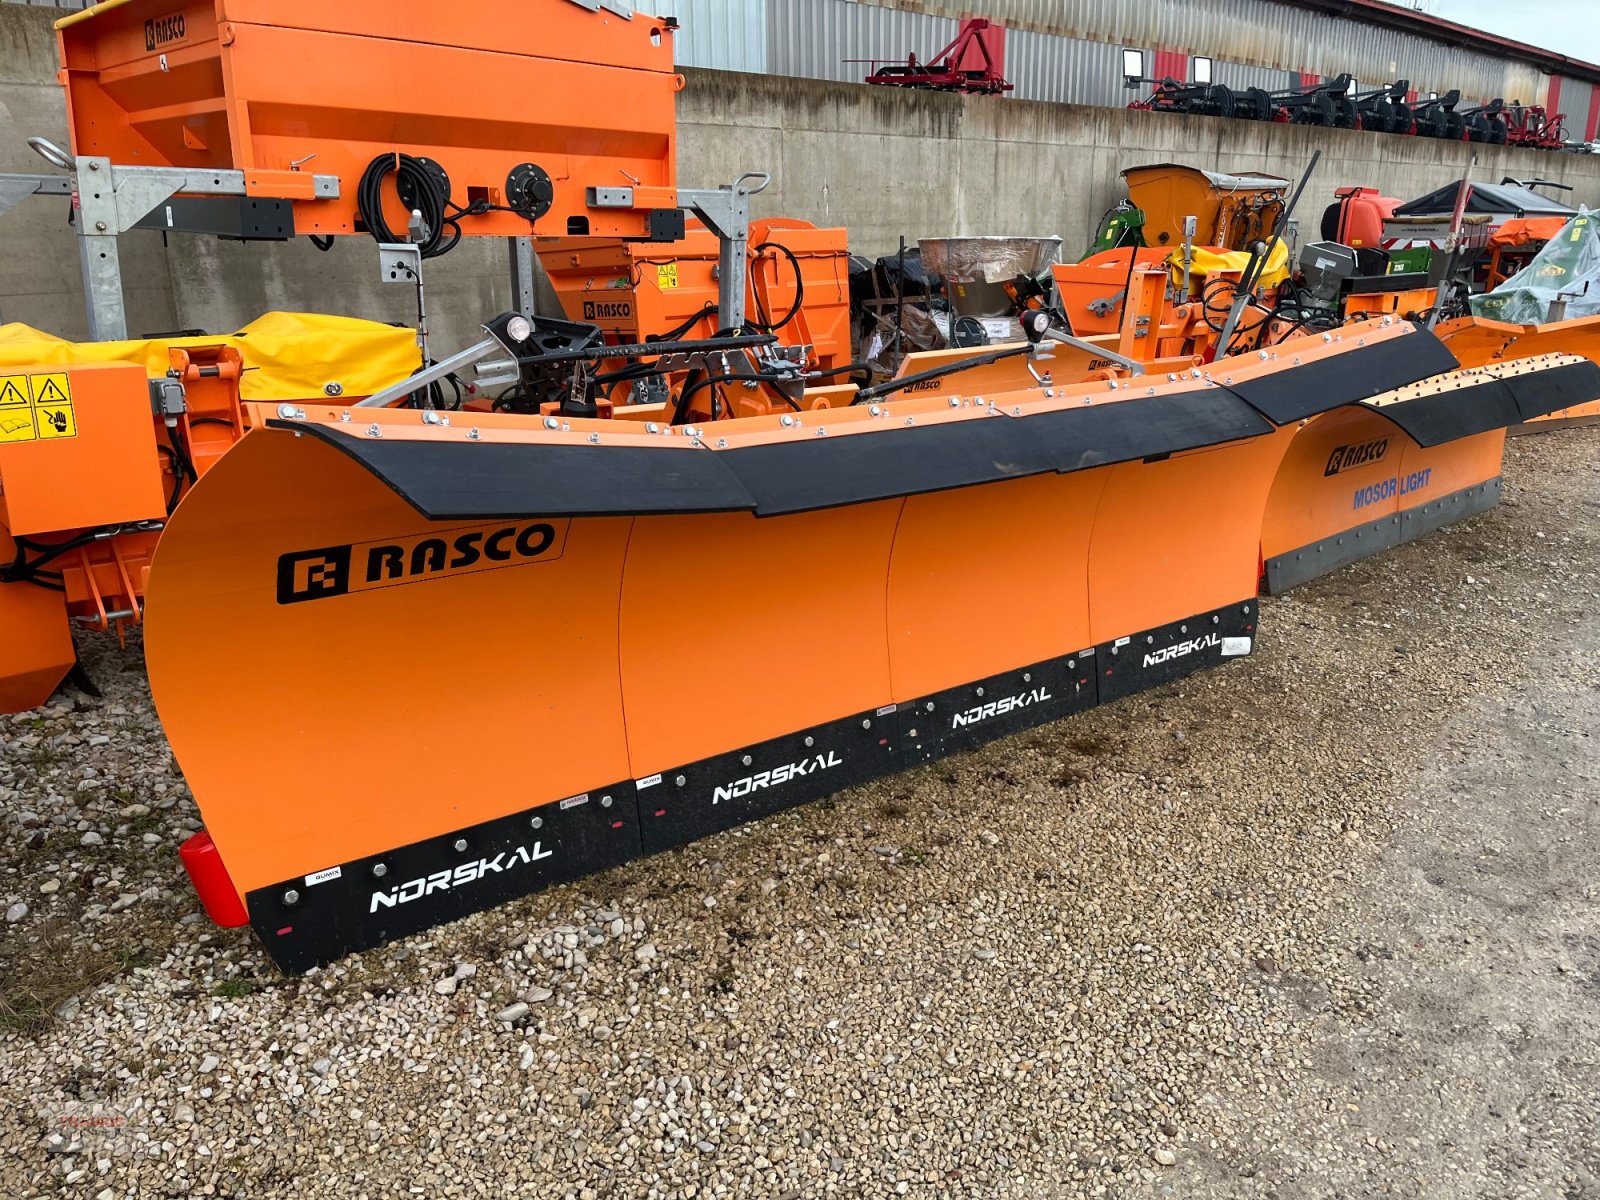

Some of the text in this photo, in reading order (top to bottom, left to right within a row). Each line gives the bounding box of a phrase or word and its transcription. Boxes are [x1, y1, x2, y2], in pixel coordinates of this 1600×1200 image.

[156, 14, 184, 43] RASCO
[597, 304, 630, 317] RASCO
[914, 380, 940, 390] RASCO
[1343, 439, 1388, 468] RASCO
[1353, 468, 1431, 510] MOSOR LIGHT
[366, 523, 556, 583] RASCO
[1142, 632, 1221, 668] NORSKAL
[952, 686, 1052, 729] NORSKAL
[712, 750, 842, 805] NORSKAL
[369, 841, 553, 914] NORSKAL
